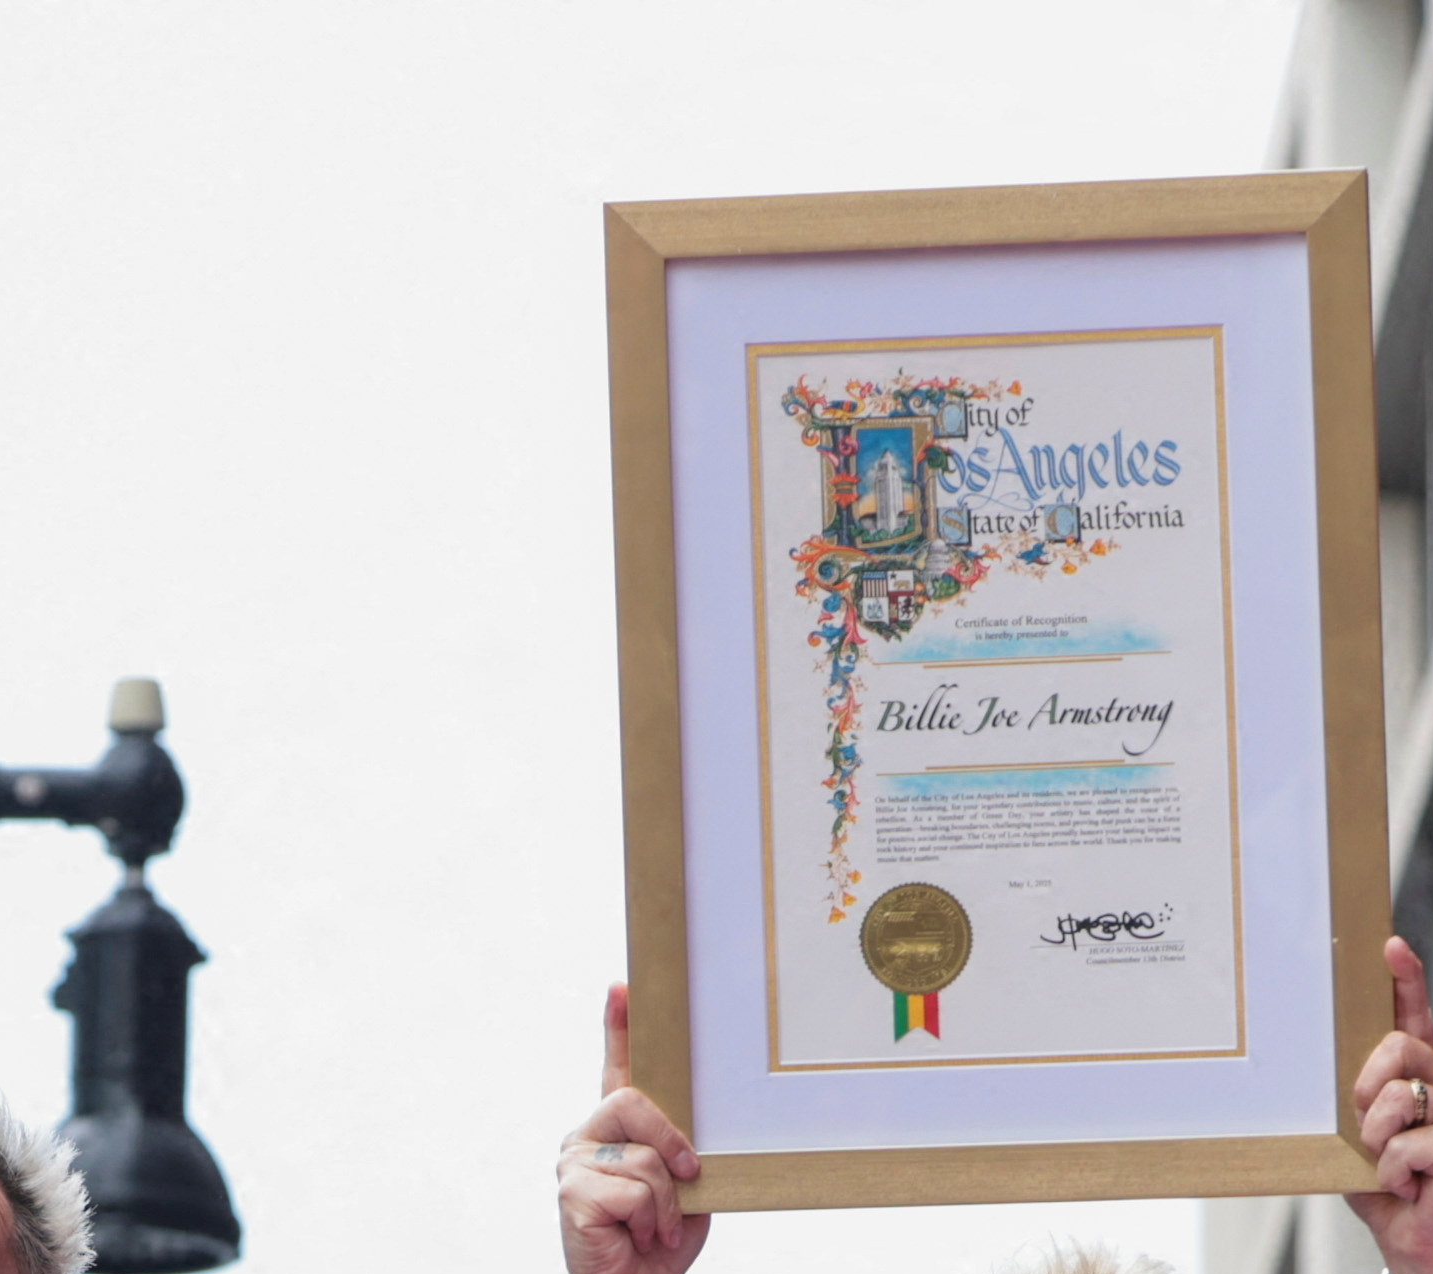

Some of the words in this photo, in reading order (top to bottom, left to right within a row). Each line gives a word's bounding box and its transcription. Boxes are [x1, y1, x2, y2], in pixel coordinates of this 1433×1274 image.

[934, 400, 999, 440] City
[1005, 397, 1034, 427] of
[991, 427, 1181, 500] Angeles
[938, 503, 1015, 546] State
[1019, 503, 1042, 535] of
[1044, 498, 1185, 543] California
[955, 617, 1008, 630] Certificate
[1011, 616, 1024, 628] of
[1026, 613, 1088, 628] Recognition
[876, 684, 962, 733] Billie
[963, 696, 1022, 735] Joe
[1028, 693, 1175, 756] Armstrong
